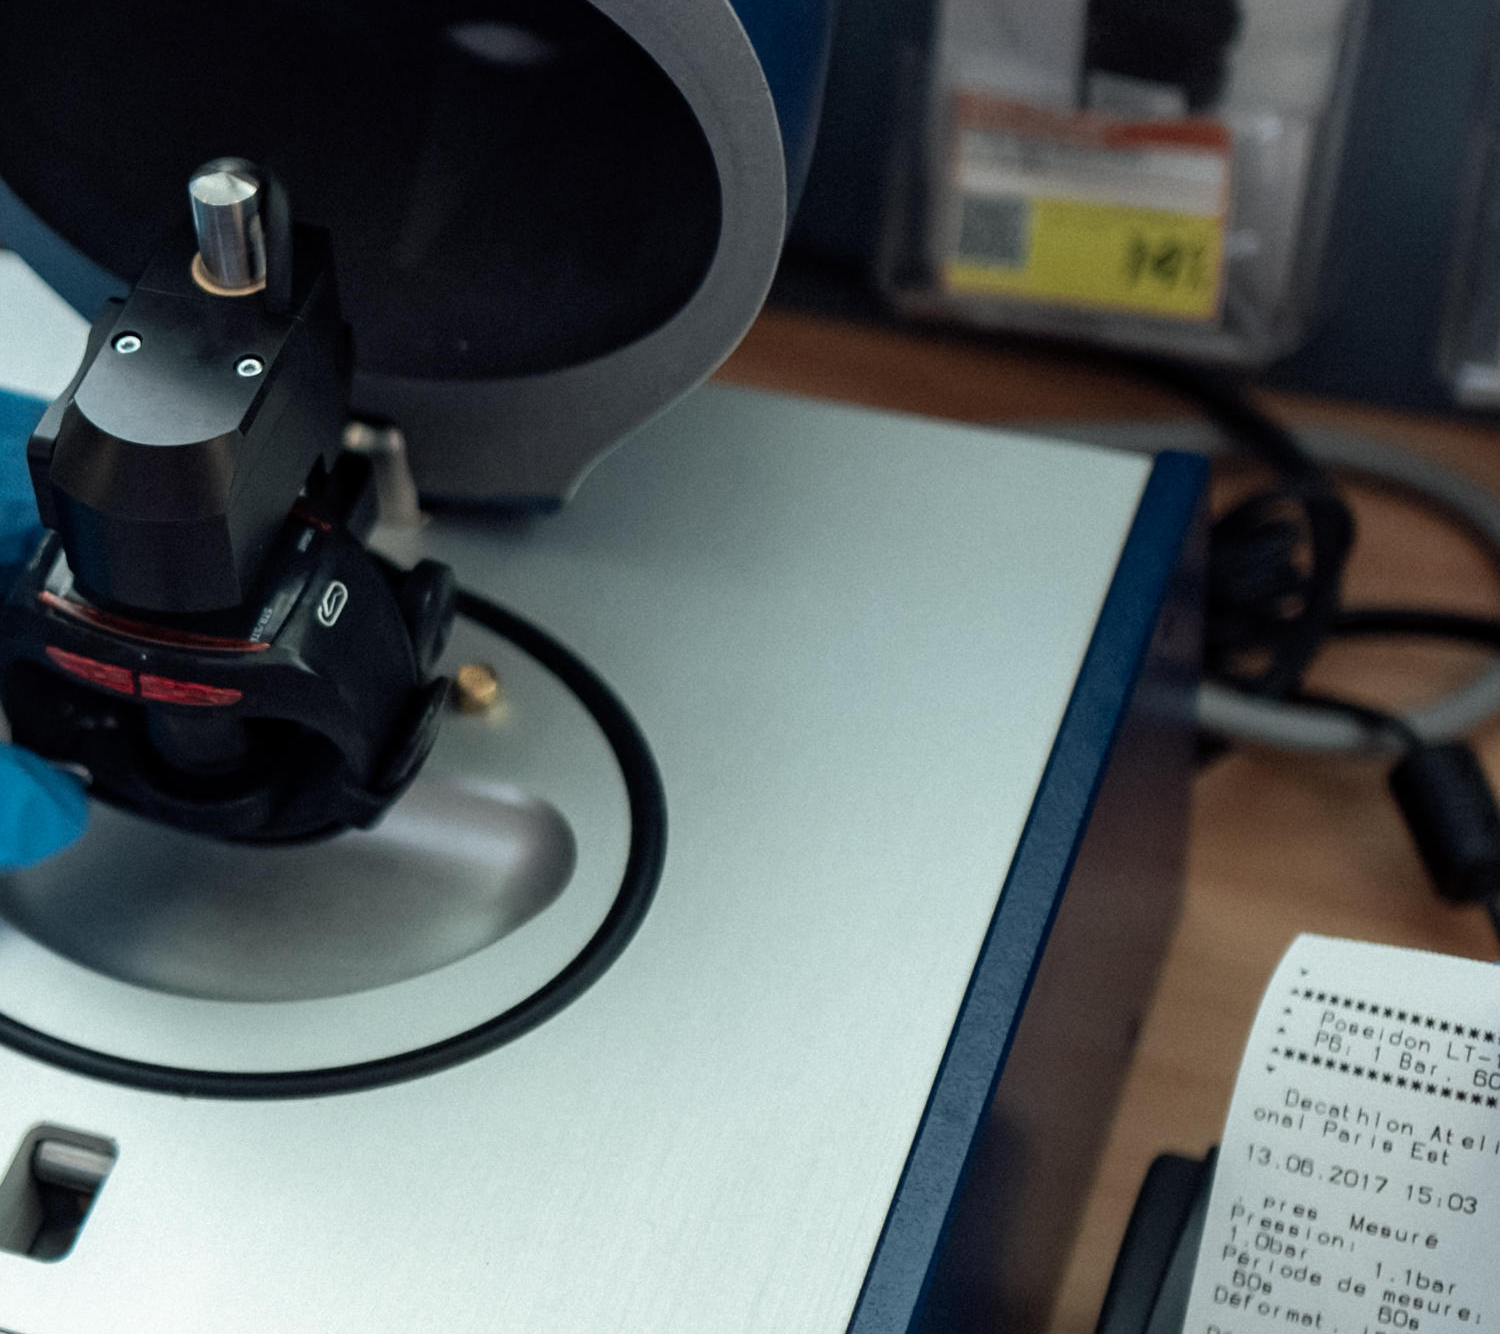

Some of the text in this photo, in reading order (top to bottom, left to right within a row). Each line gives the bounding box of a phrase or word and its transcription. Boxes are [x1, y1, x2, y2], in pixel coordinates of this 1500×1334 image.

[1320, 1010, 1432, 1053] Poseidon
[1284, 1087, 1414, 1137] Decathlon
[1253, 1106, 1451, 1166] onal Paris Est
[1406, 1183, 1479, 1216] 15:03
[1349, 1214, 1440, 1251] Mesuré
[1337, 1276, 1367, 1297] de
[1375, 1261, 1457, 1296] 1.1bar
